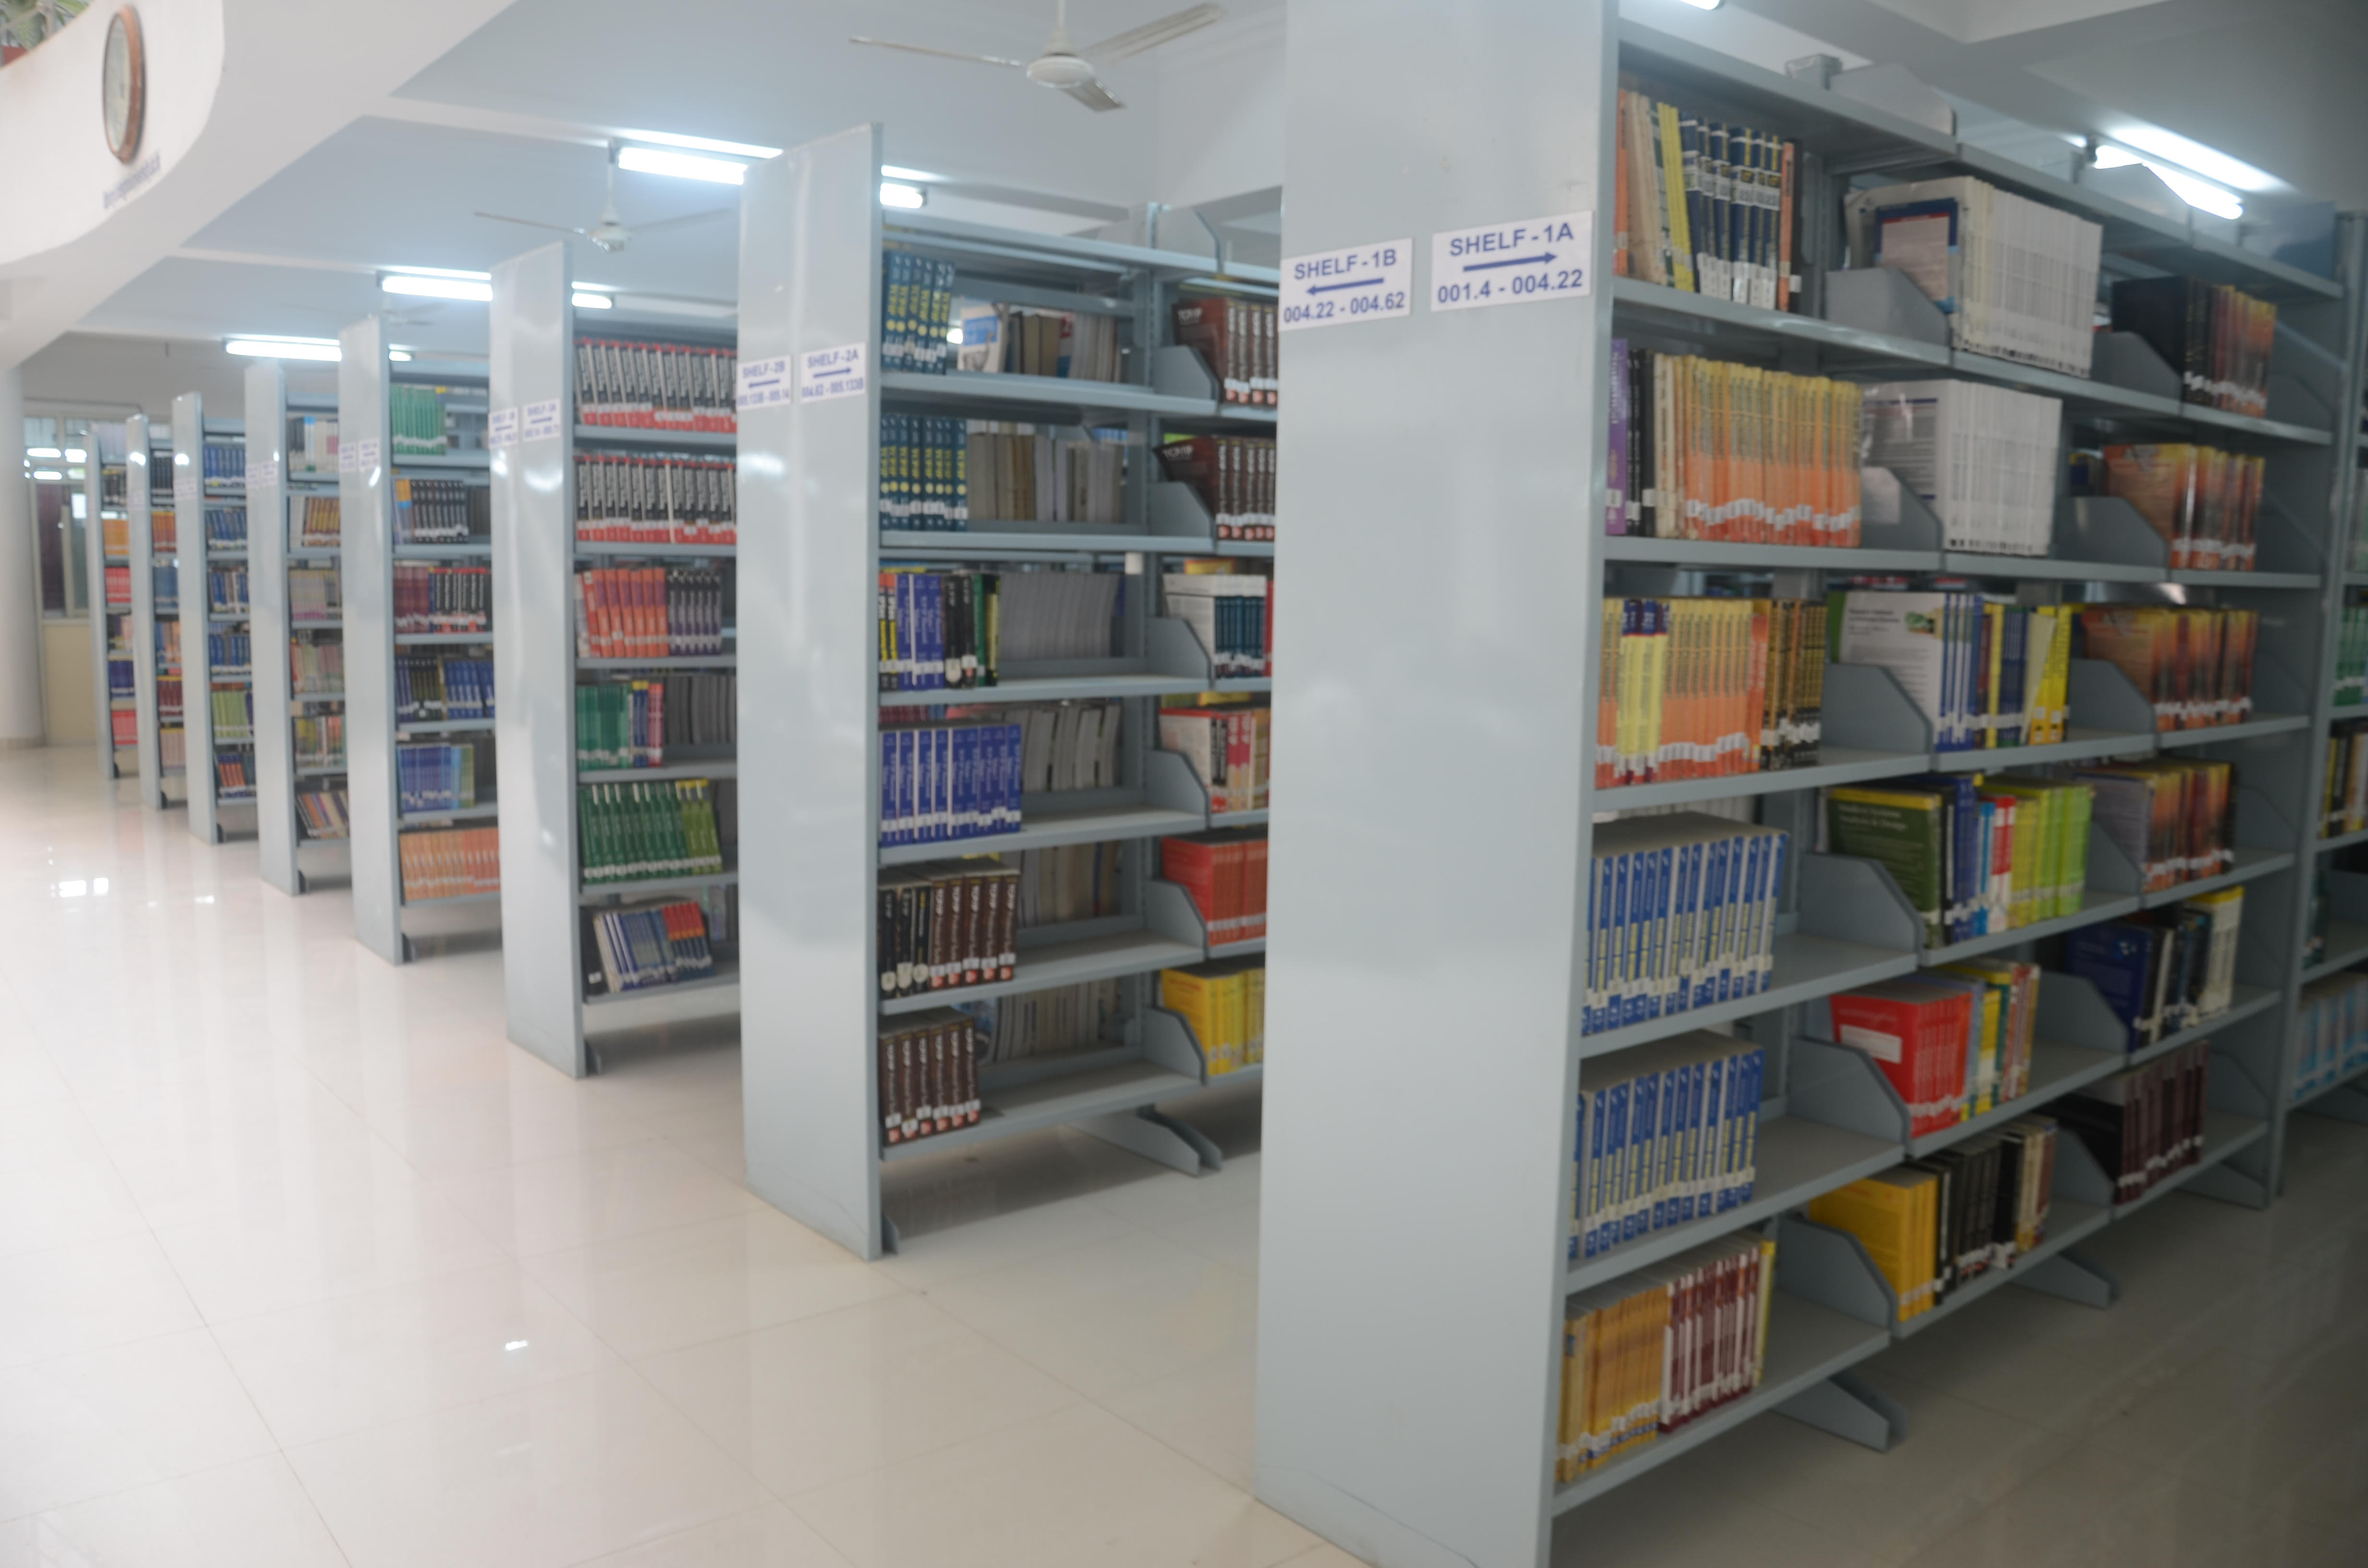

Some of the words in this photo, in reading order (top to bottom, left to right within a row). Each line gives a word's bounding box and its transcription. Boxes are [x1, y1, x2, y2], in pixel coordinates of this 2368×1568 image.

[1437, 281, 1491, 304] 001.4
[1513, 270, 1583, 294] 004.22
[1283, 301, 1334, 323] 004.22
[1350, 292, 1405, 315] 004.62
